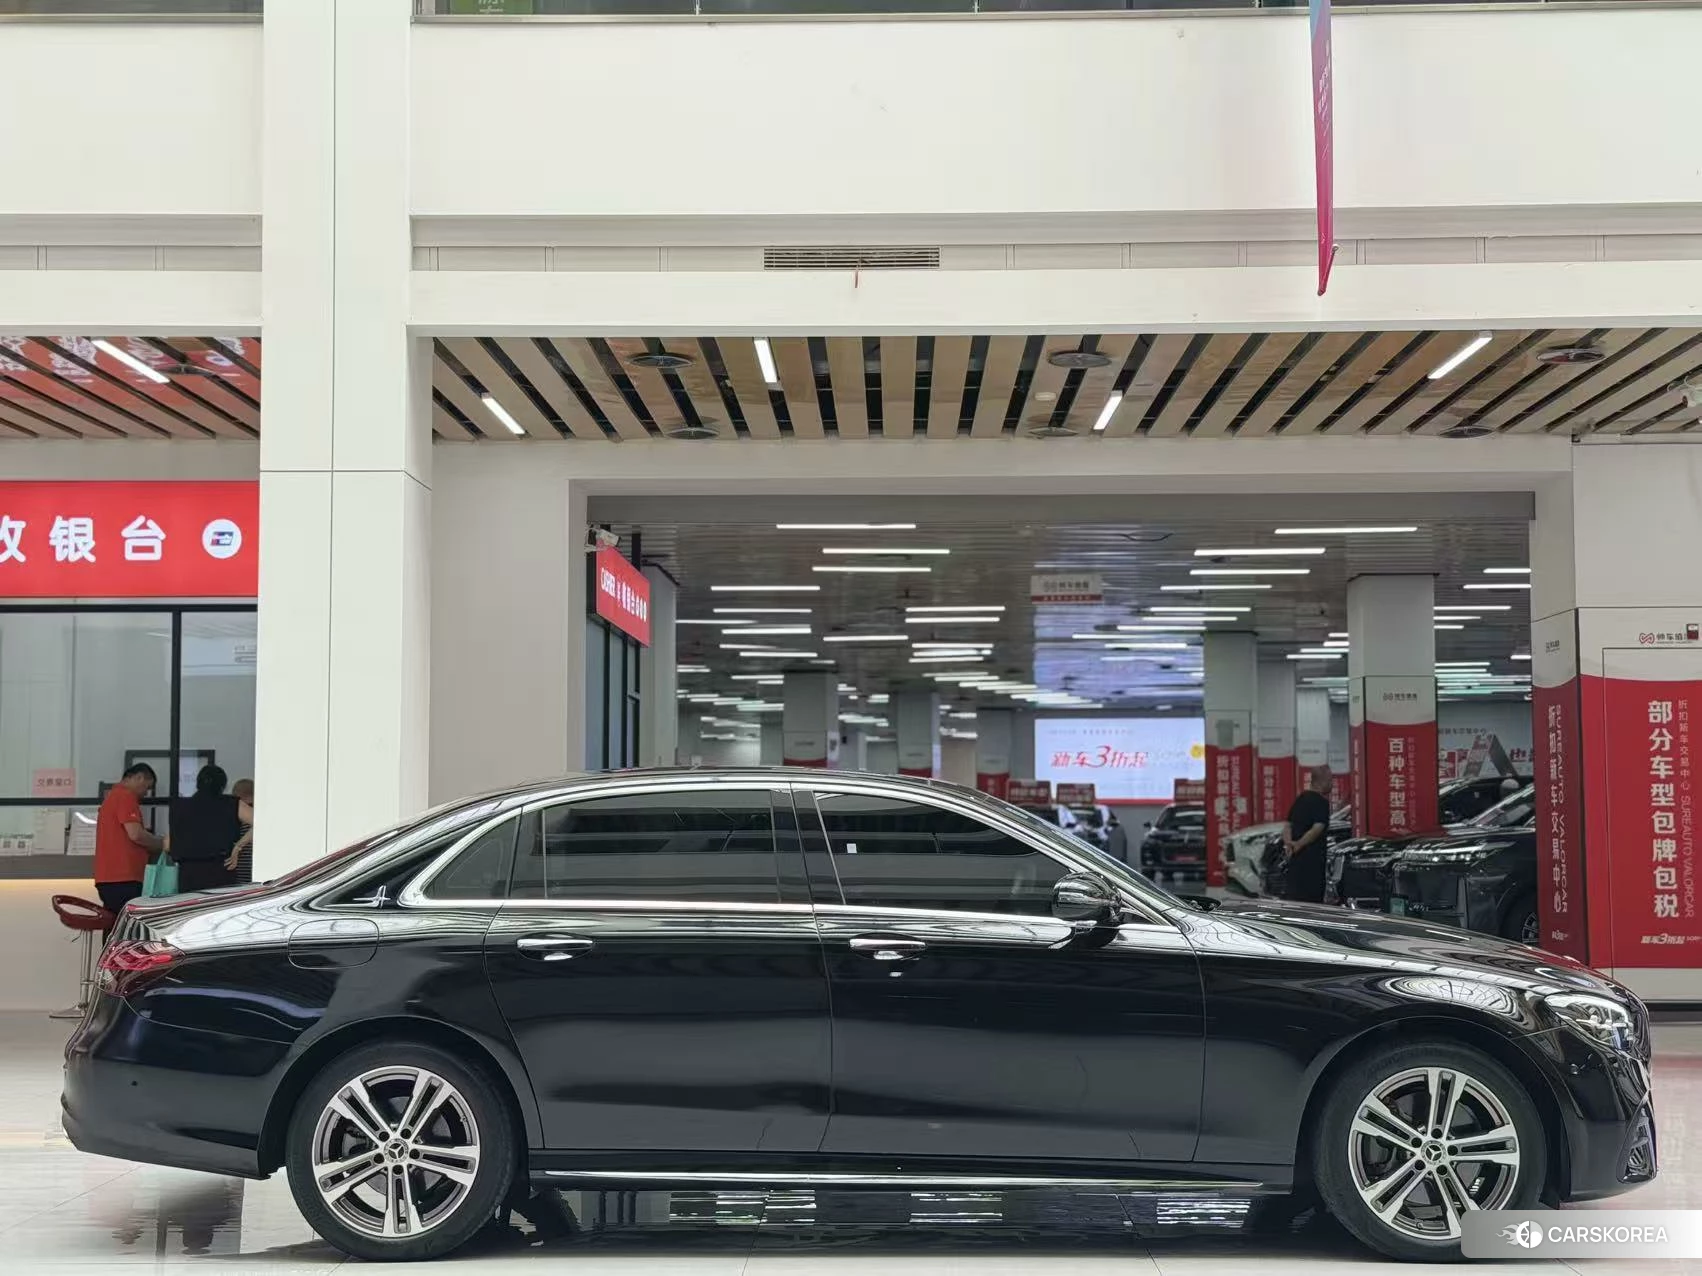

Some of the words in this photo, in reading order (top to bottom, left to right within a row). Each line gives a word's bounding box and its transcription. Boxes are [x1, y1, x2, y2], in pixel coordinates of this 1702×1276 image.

[1388, 738, 1407, 834] 百种车型高
[1648, 700, 1680, 918] 部分车型包牌包税
